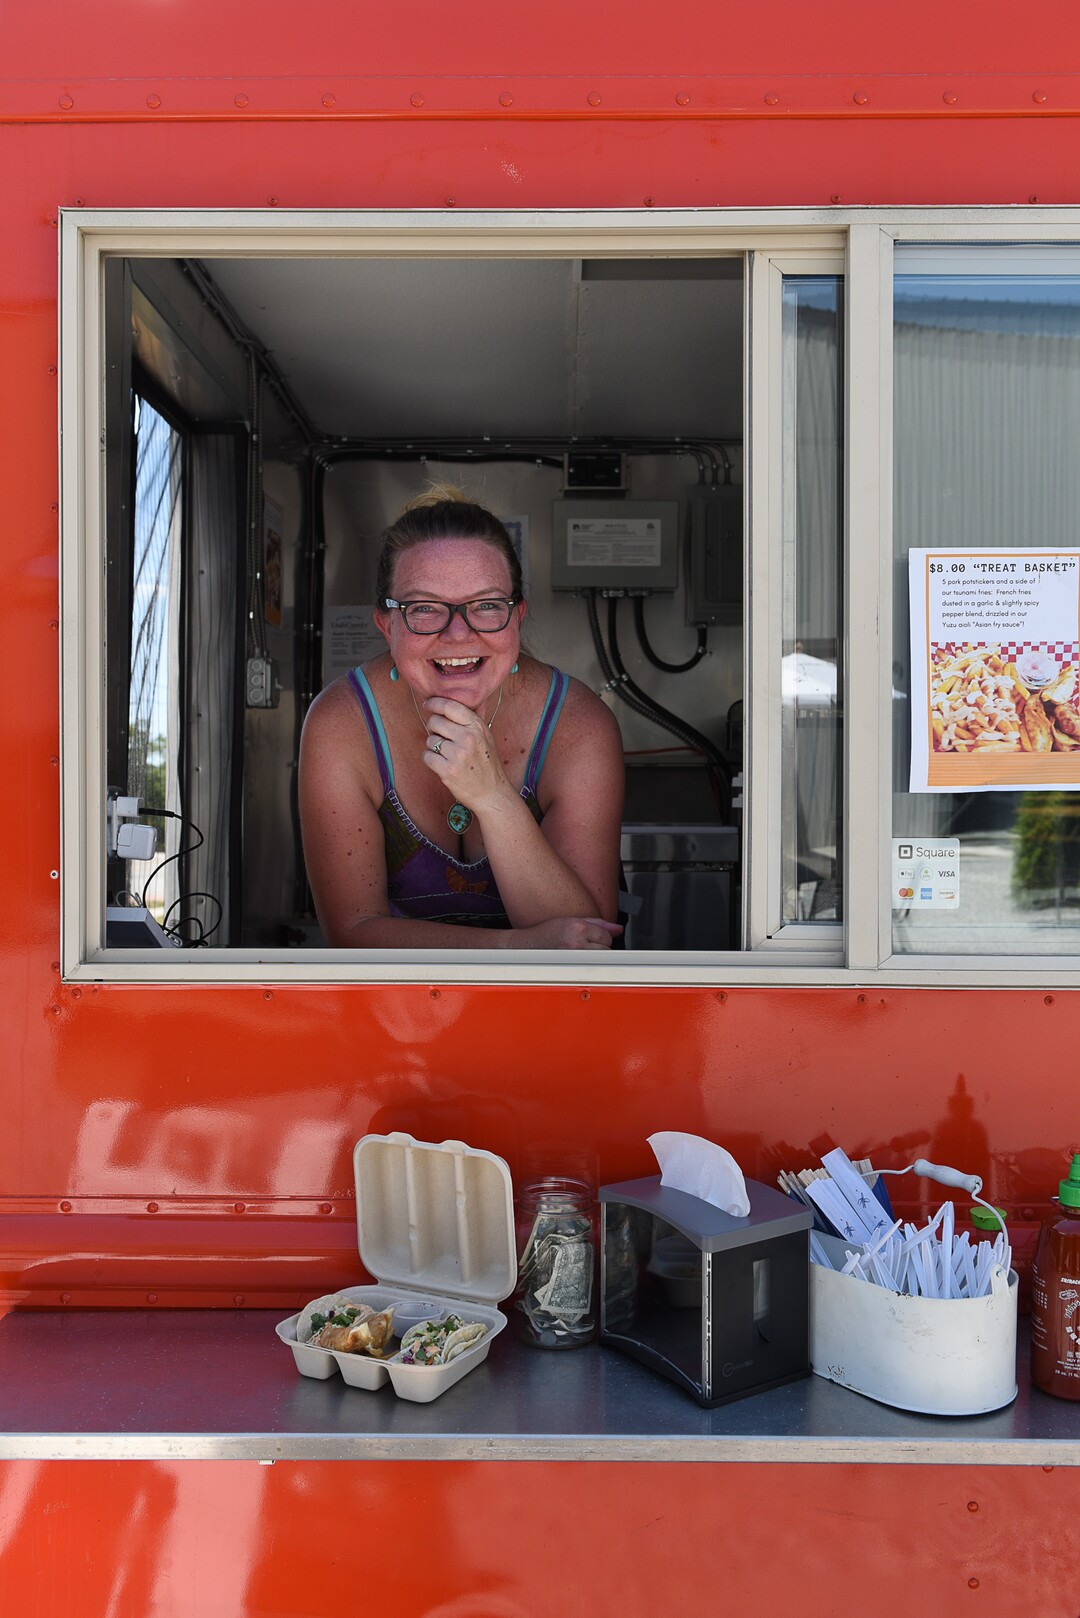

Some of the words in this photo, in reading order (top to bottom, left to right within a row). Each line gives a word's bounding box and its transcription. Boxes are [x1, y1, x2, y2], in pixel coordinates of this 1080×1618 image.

[930, 563, 965, 573] $8.00
[974, 564, 1016, 572] “TREAT
[1025, 563, 1076, 572] BASKET”
[916, 847, 955, 859] Square
